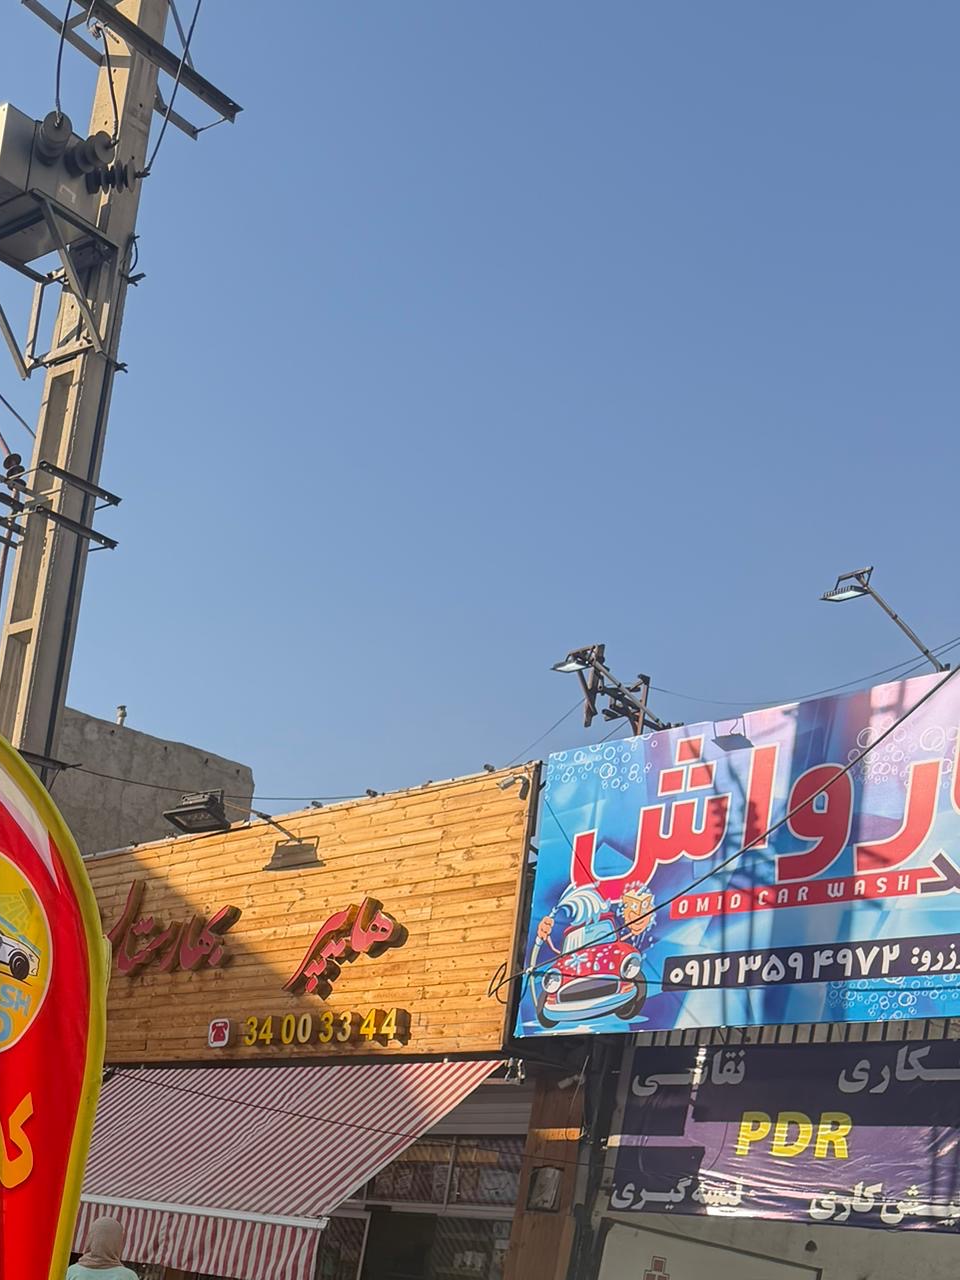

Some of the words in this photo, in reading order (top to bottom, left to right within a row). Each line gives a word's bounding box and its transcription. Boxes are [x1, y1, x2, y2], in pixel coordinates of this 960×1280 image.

[678, 893, 741, 915] OMID
[758, 886, 808, 906] CAR
[827, 875, 910, 898] WASH
[669, 957, 730, 987] ۰۹۱۲
[737, 951, 803, 984] ۳۵۹
[812, 944, 900, 980] ۴۹۷۲
[244, 1015, 273, 1046] 34
[281, 1013, 313, 1045] 00
[318, 1010, 352, 1043] 33
[360, 1007, 398, 1041] 44
[735, 1111, 854, 1159] PDR
